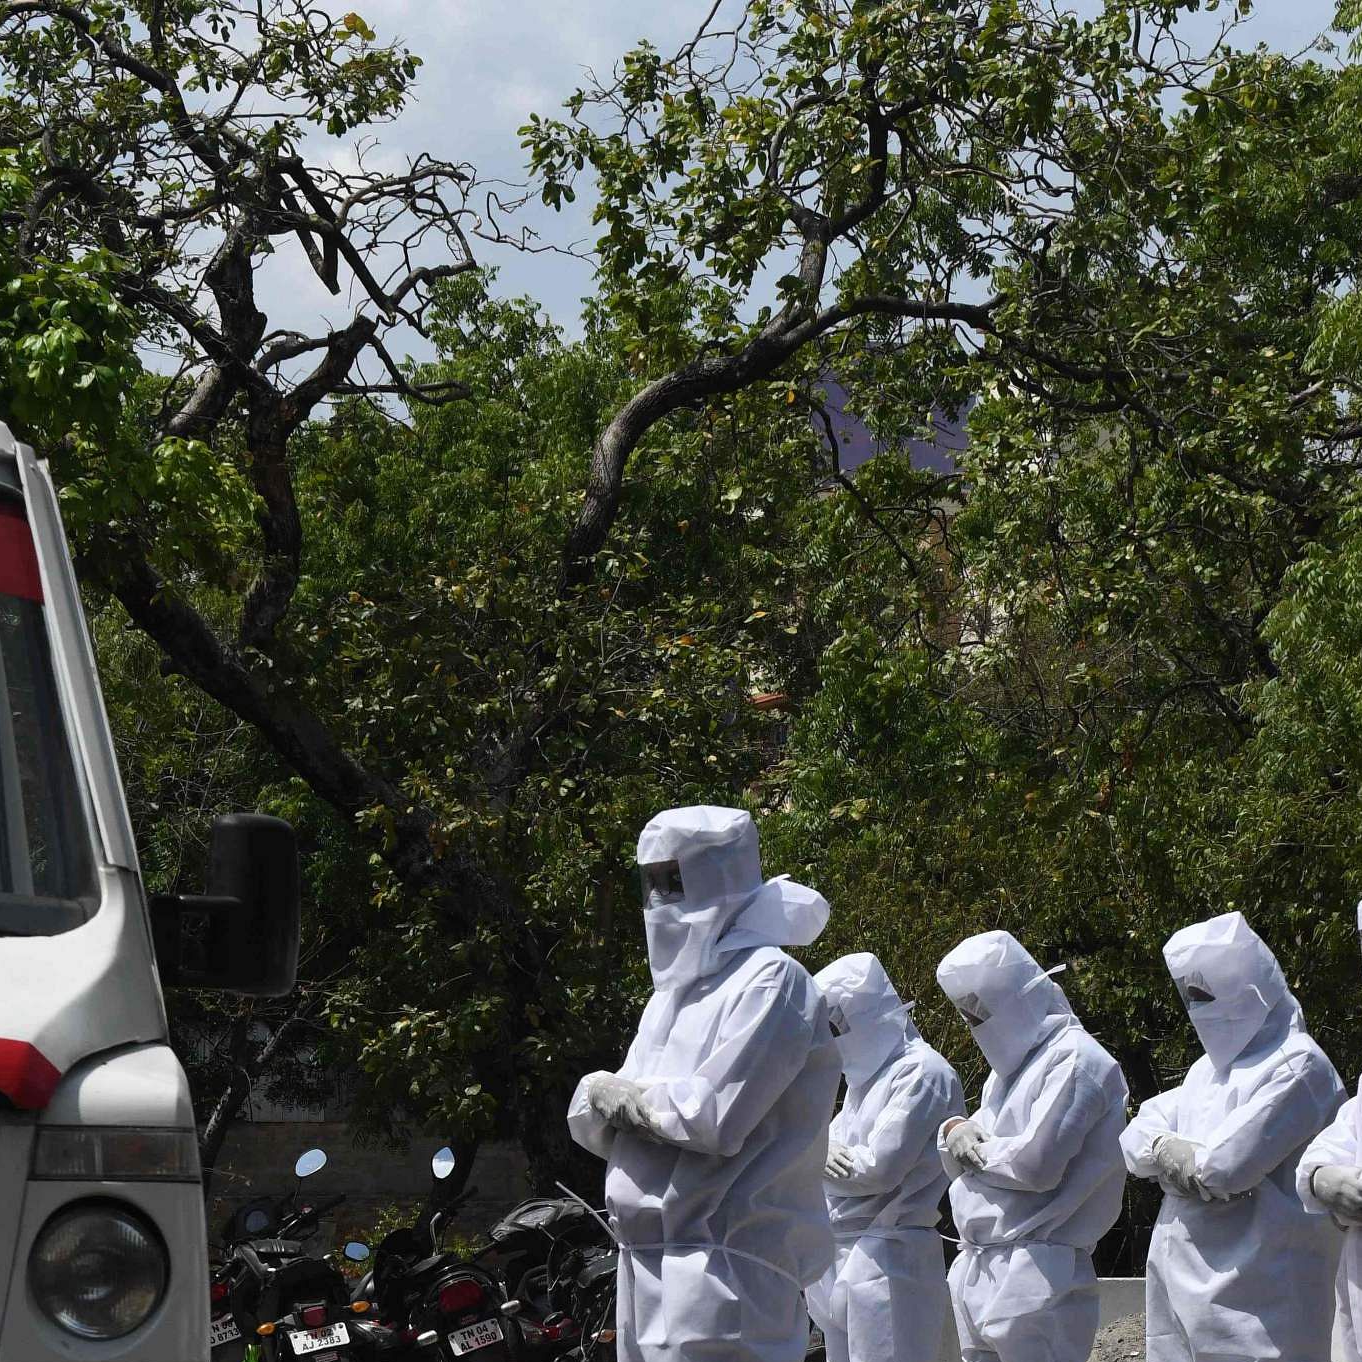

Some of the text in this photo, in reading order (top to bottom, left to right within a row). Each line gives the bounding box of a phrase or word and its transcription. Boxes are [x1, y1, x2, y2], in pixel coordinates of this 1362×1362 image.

[304, 1331, 318, 1340] TN
[460, 1324, 488, 1341] TN 04
[302, 1341, 314, 1351] AJ
[461, 1341, 473, 1352] AL
